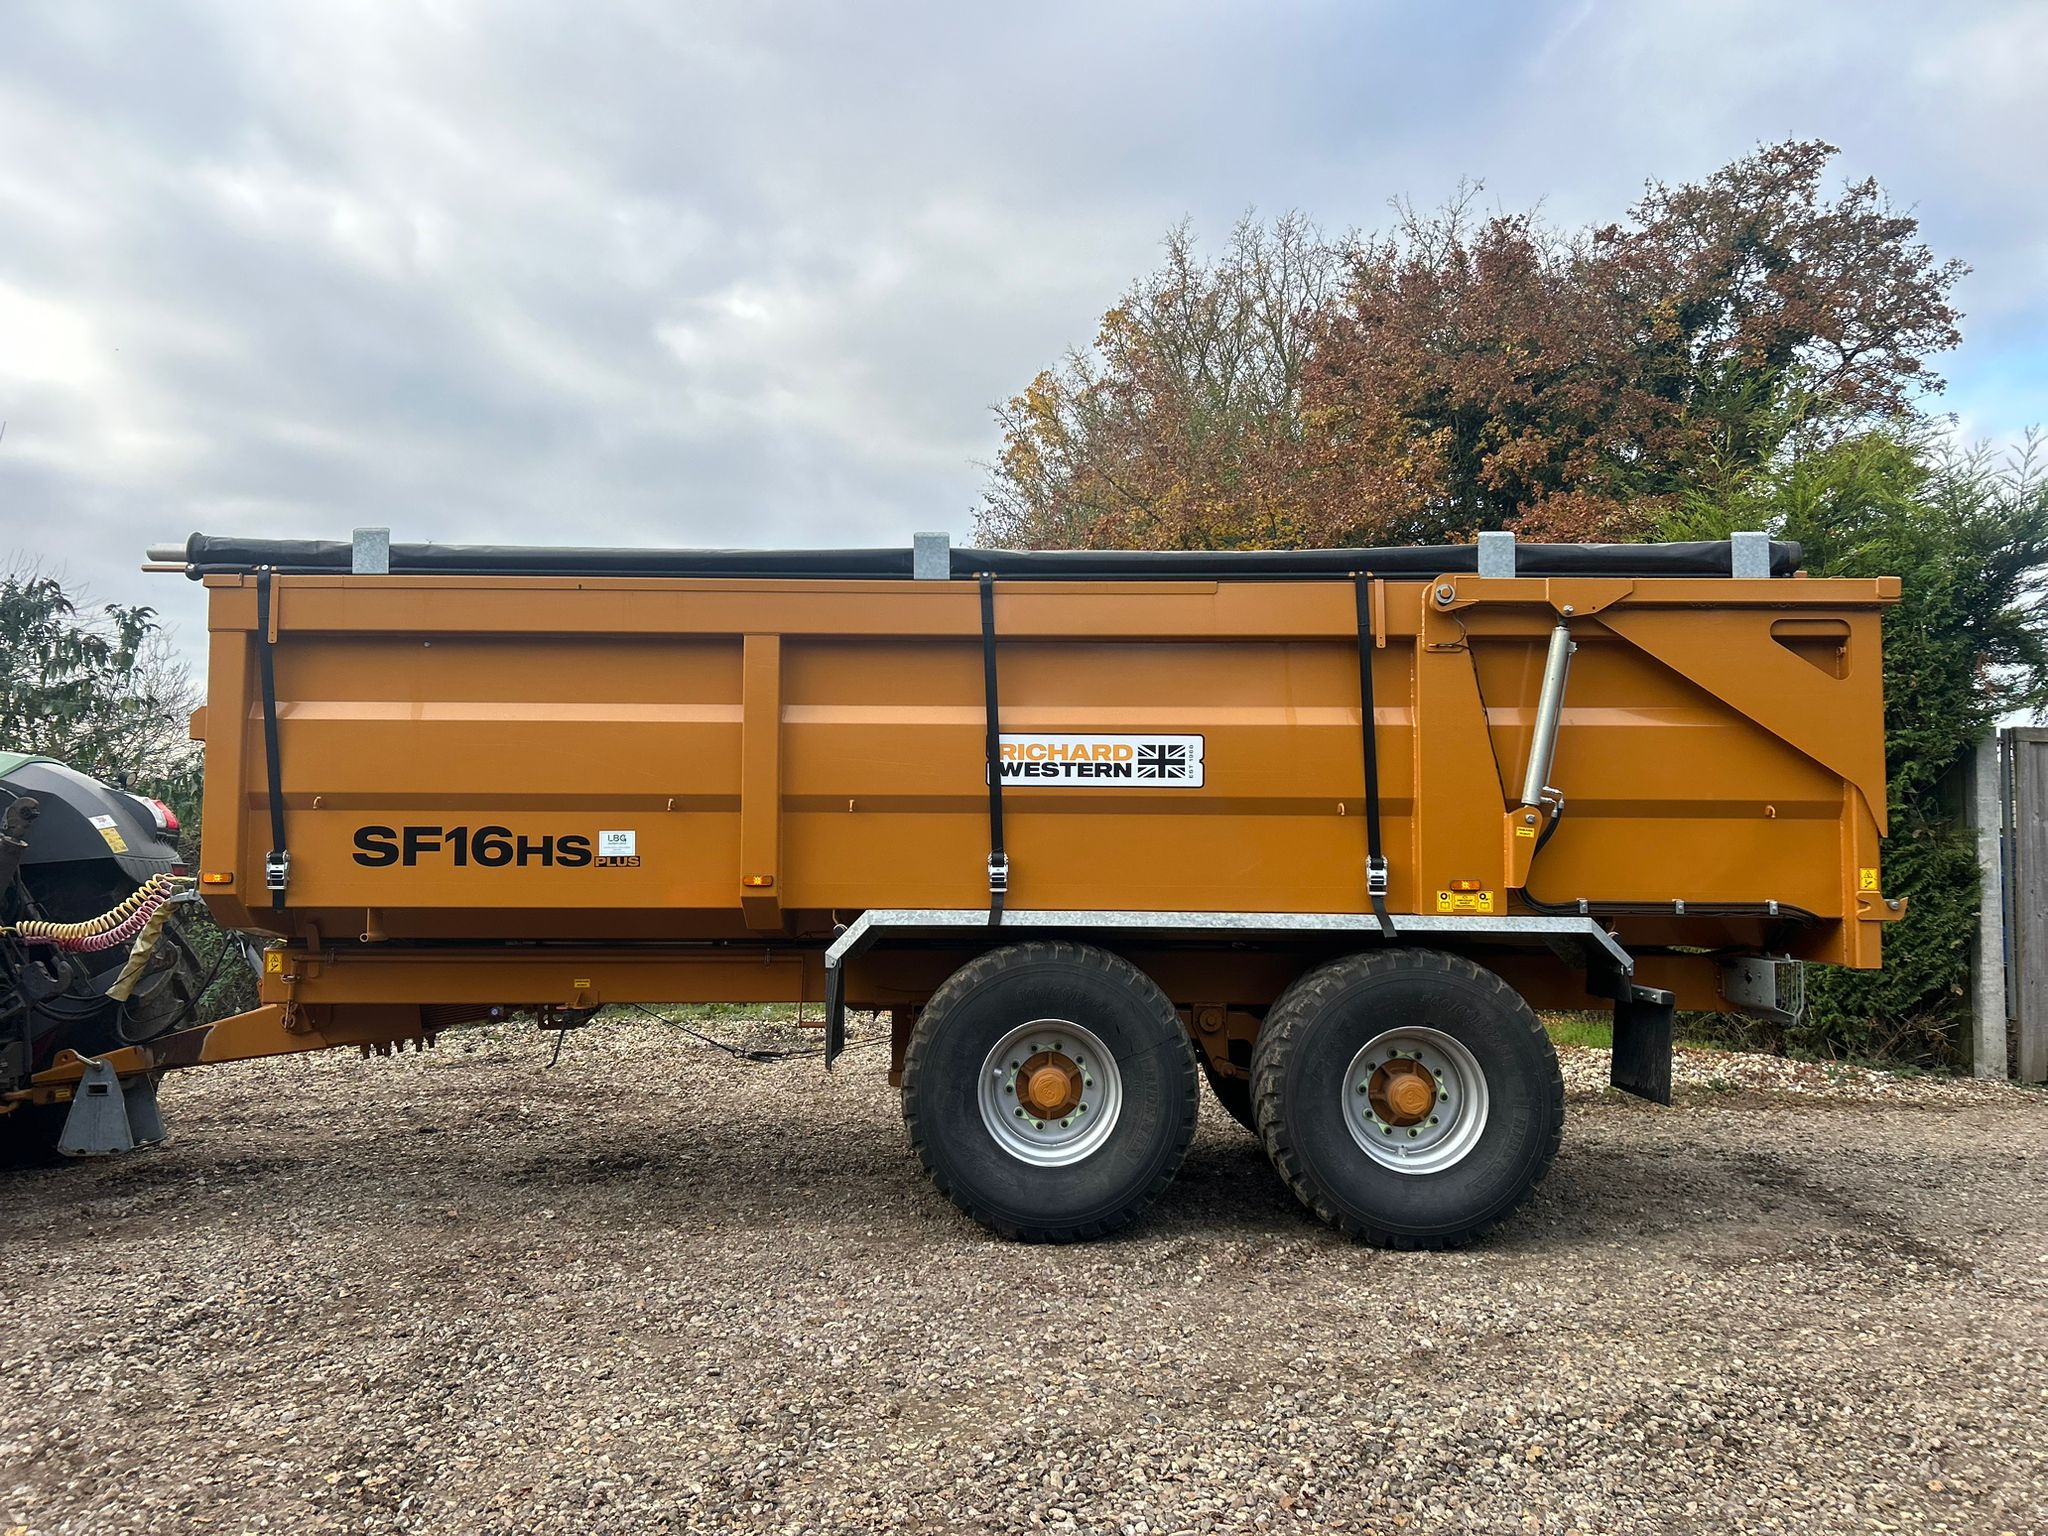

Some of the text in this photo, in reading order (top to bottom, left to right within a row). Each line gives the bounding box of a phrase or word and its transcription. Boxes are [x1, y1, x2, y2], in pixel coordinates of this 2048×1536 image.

[999, 743, 1133, 761] RICHARD
[999, 761, 1132, 778] WESTERN
[352, 825, 592, 867] SF16HS
[595, 856, 640, 867] PLUS
